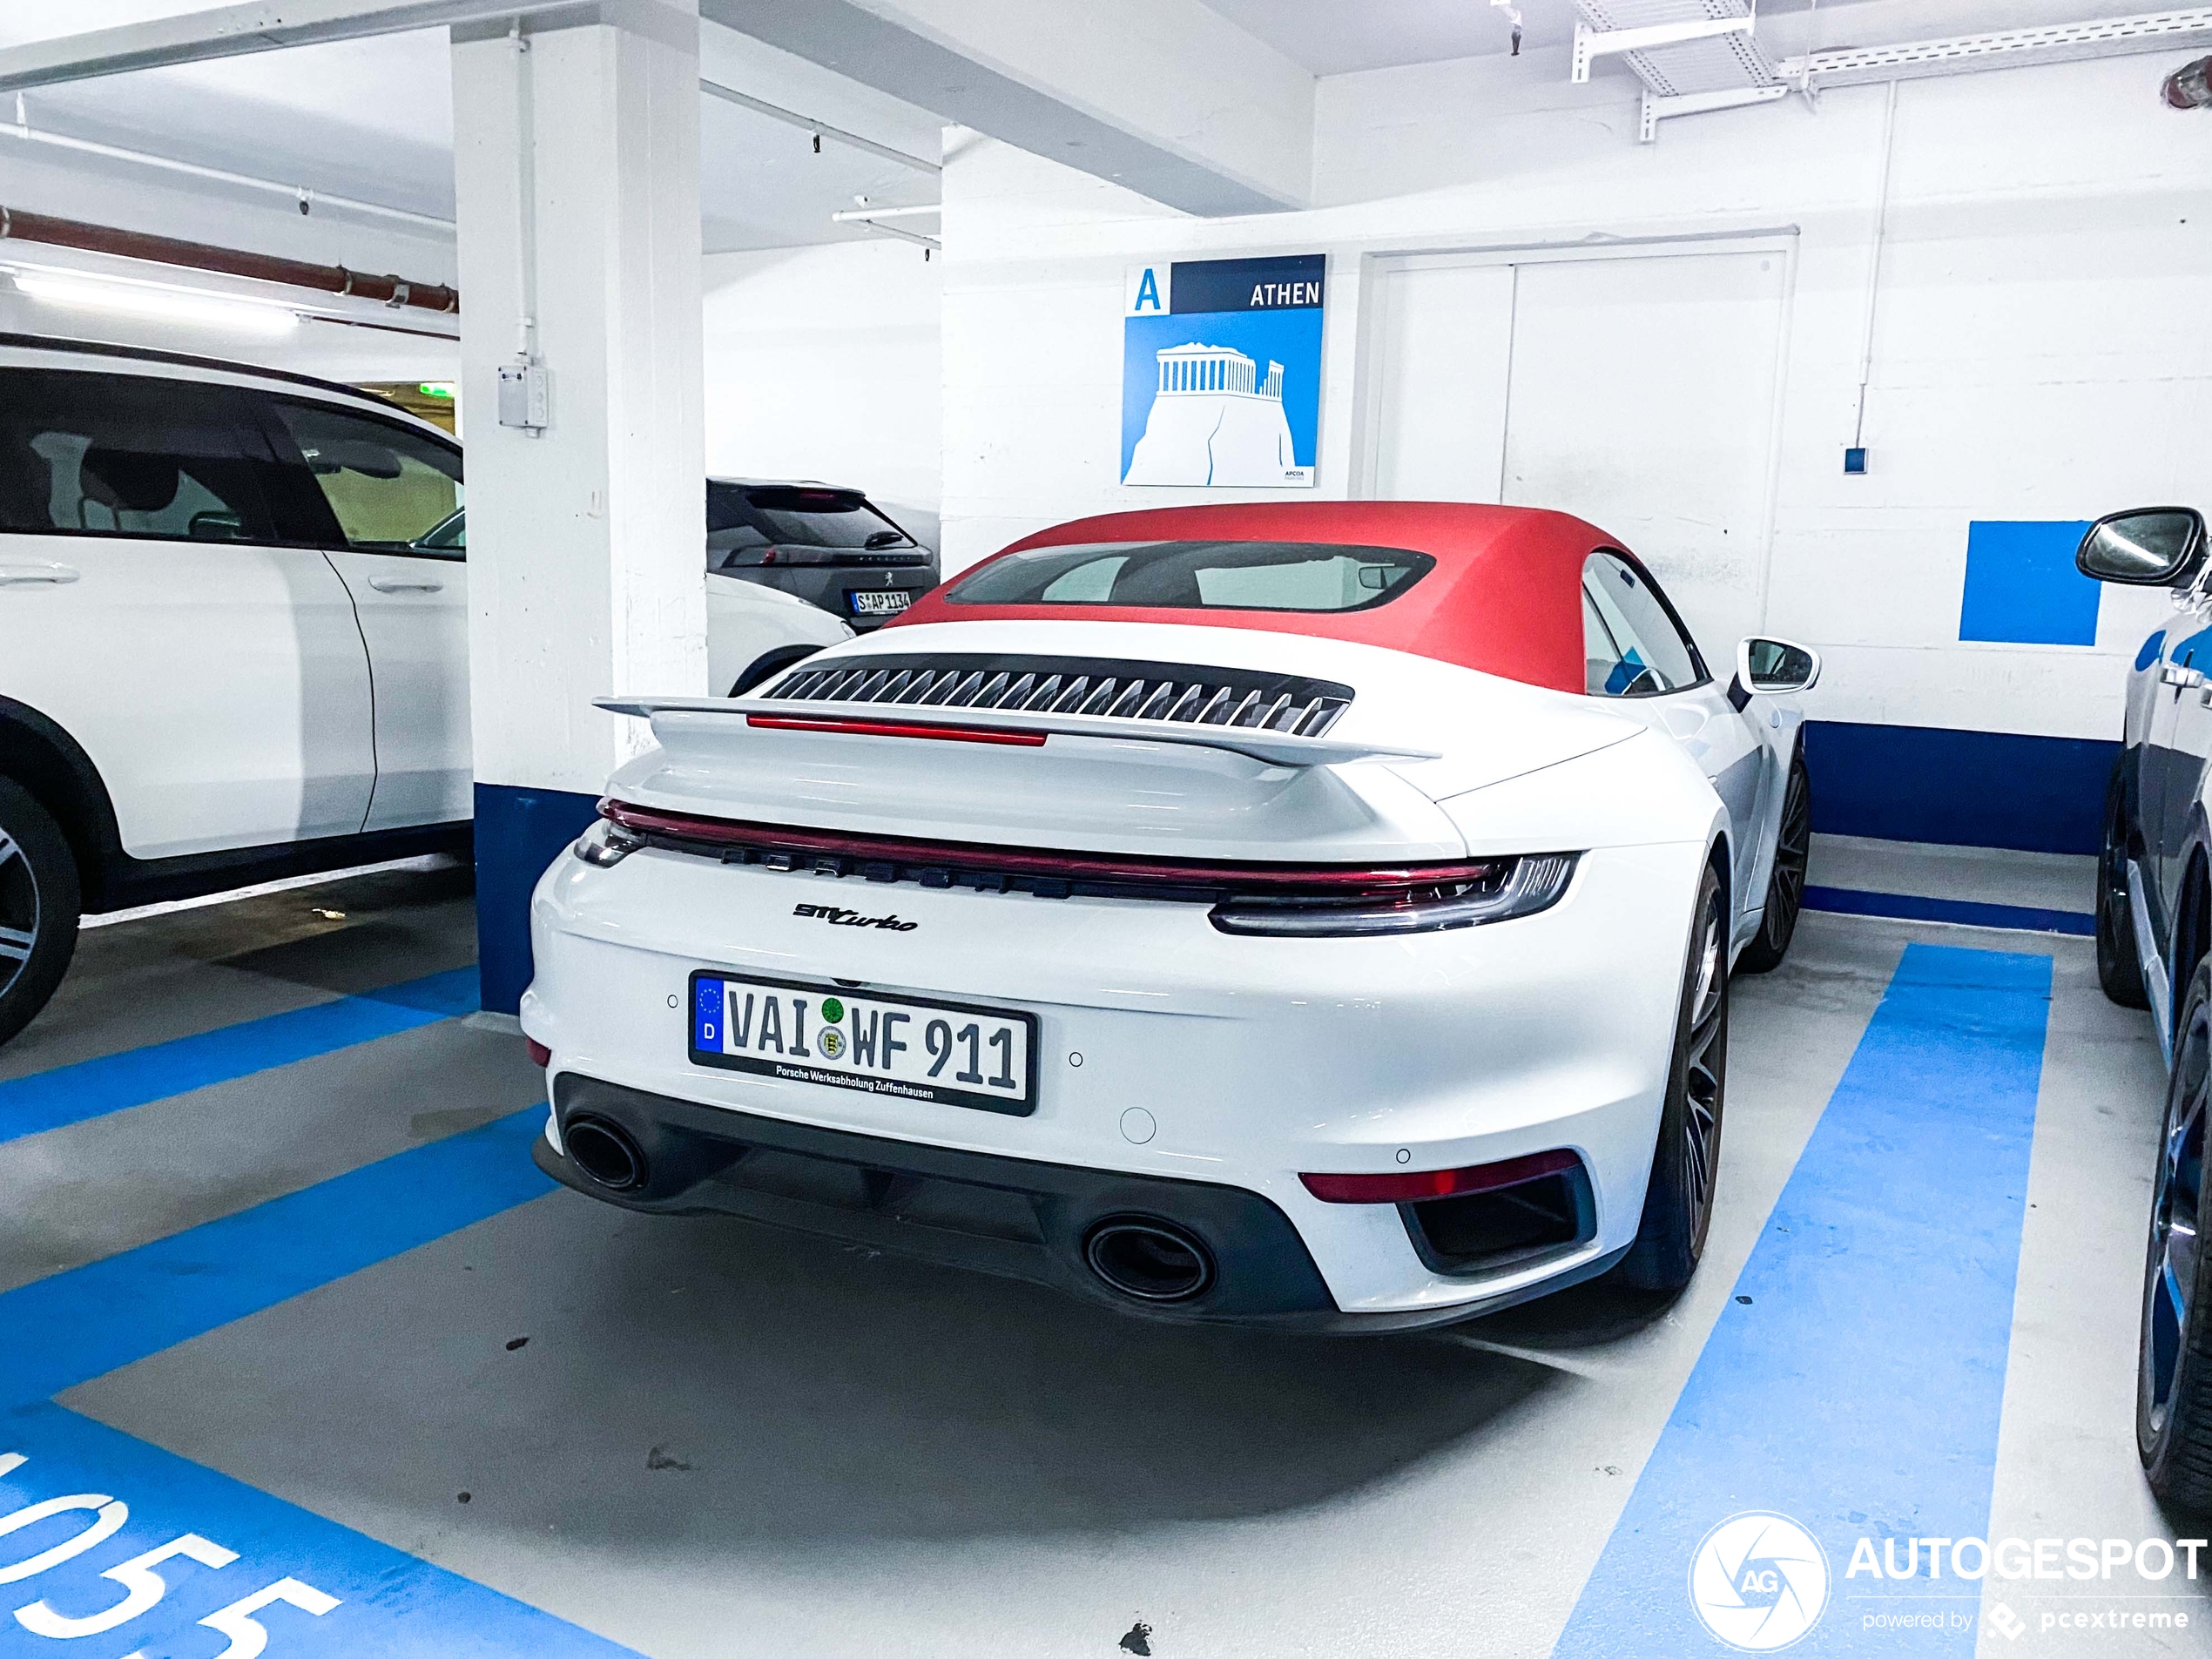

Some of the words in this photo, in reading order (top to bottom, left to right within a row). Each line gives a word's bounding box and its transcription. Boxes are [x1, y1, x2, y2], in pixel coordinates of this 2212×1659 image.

[1135, 268, 1161, 311] A
[1251, 282, 1319, 306] ATHEN
[858, 595, 866, 610] S
[872, 595, 884, 610] AP
[885, 594, 910, 609] 1134
[828, 910, 918, 931] turbo
[704, 1023, 715, 1039] D
[729, 991, 810, 1057] VAI
[852, 1008, 910, 1069] WF
[926, 1019, 1015, 1089] 911
[776, 1065, 809, 1079] Porsche
[810, 1070, 873, 1091] Werksabholung
[875, 1081, 934, 1099] Zuffenhausen
